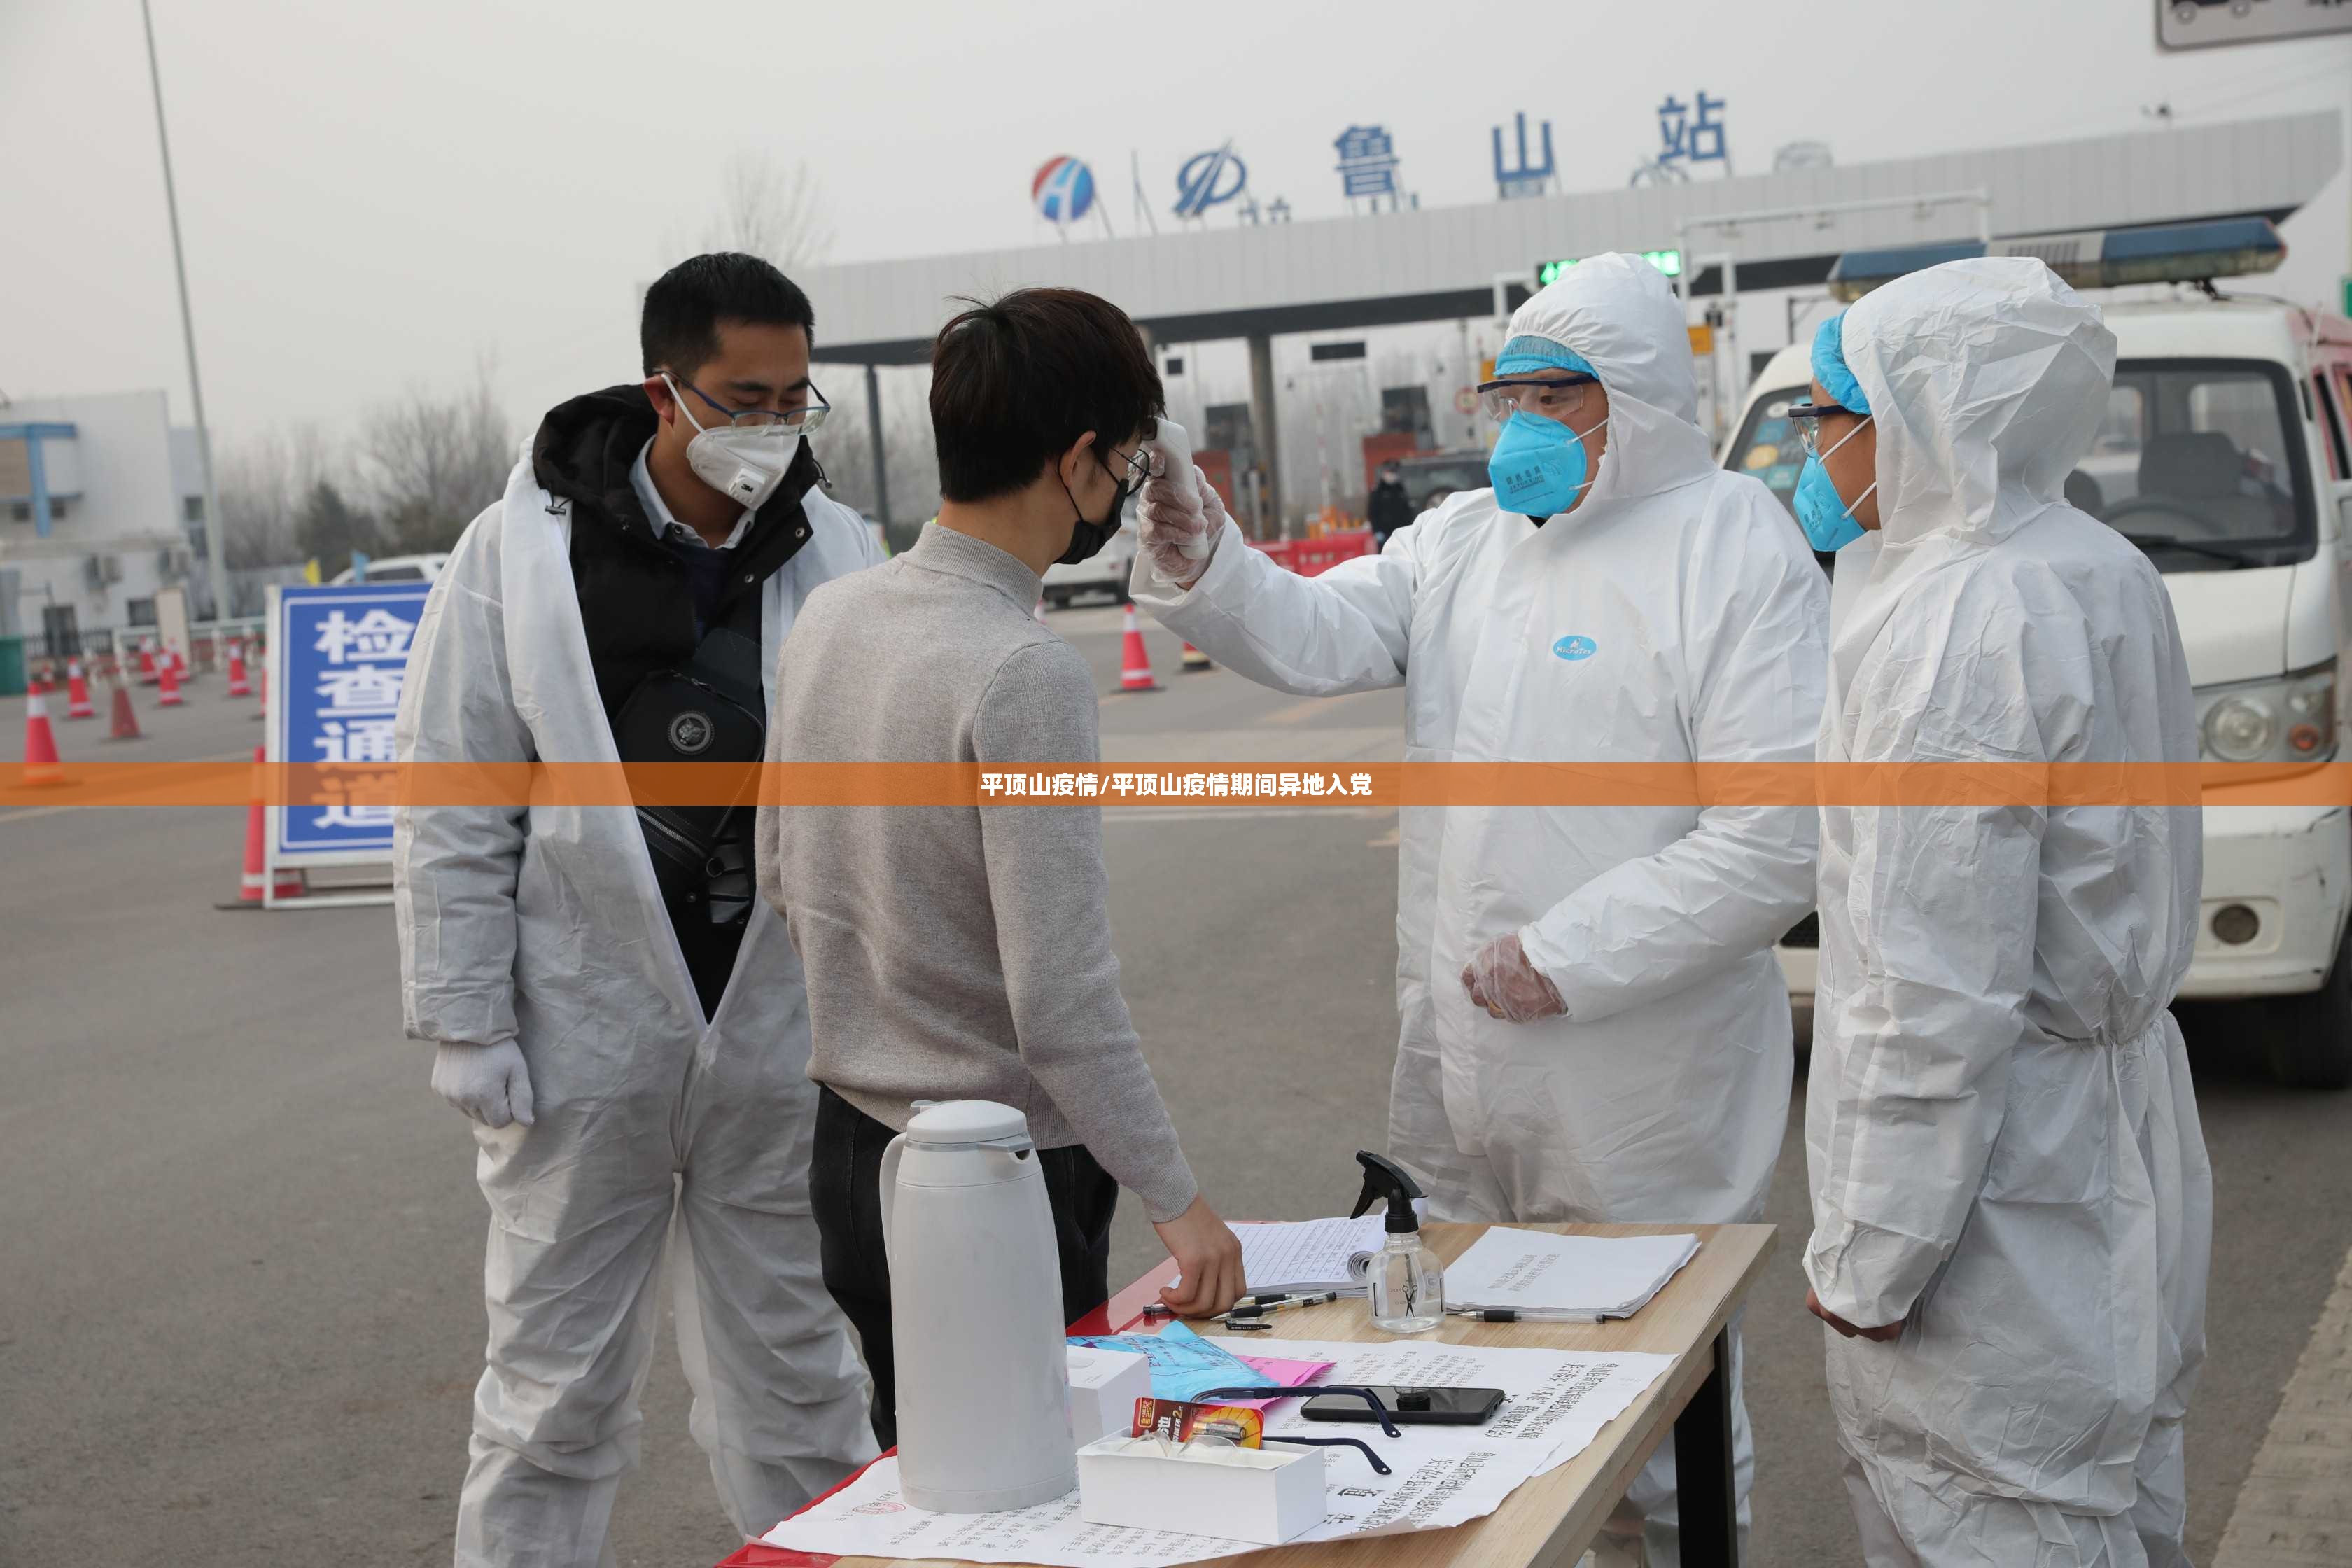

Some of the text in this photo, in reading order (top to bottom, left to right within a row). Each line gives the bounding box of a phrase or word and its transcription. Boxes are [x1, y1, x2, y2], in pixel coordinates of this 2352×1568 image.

[1333, 90, 1727, 198] 鲁山站
[741, 483, 755, 493] 3M
[311, 608, 416, 830] 检查通道
